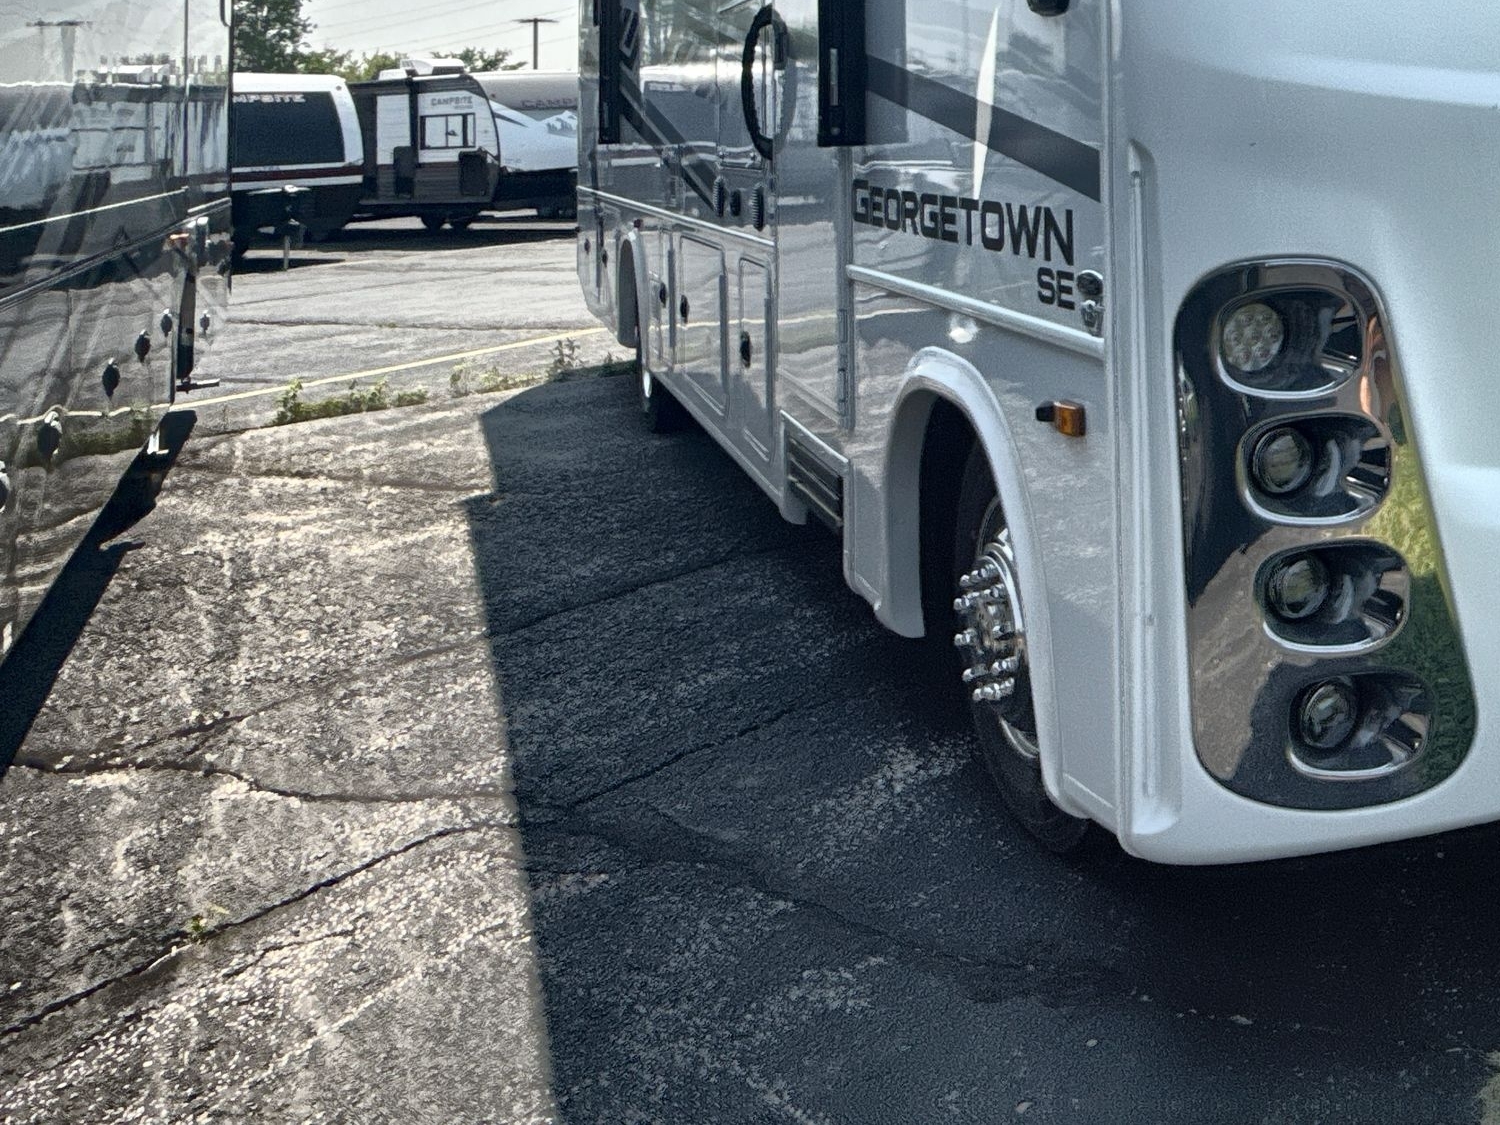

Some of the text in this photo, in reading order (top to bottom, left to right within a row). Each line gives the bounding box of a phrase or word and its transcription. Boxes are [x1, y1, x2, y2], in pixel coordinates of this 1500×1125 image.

[231, 93, 306, 103] MPSITE
[521, 97, 577, 109] CAMP
[852, 178, 1075, 267] GEORGETOWN
[1036, 265, 1076, 310] SE
